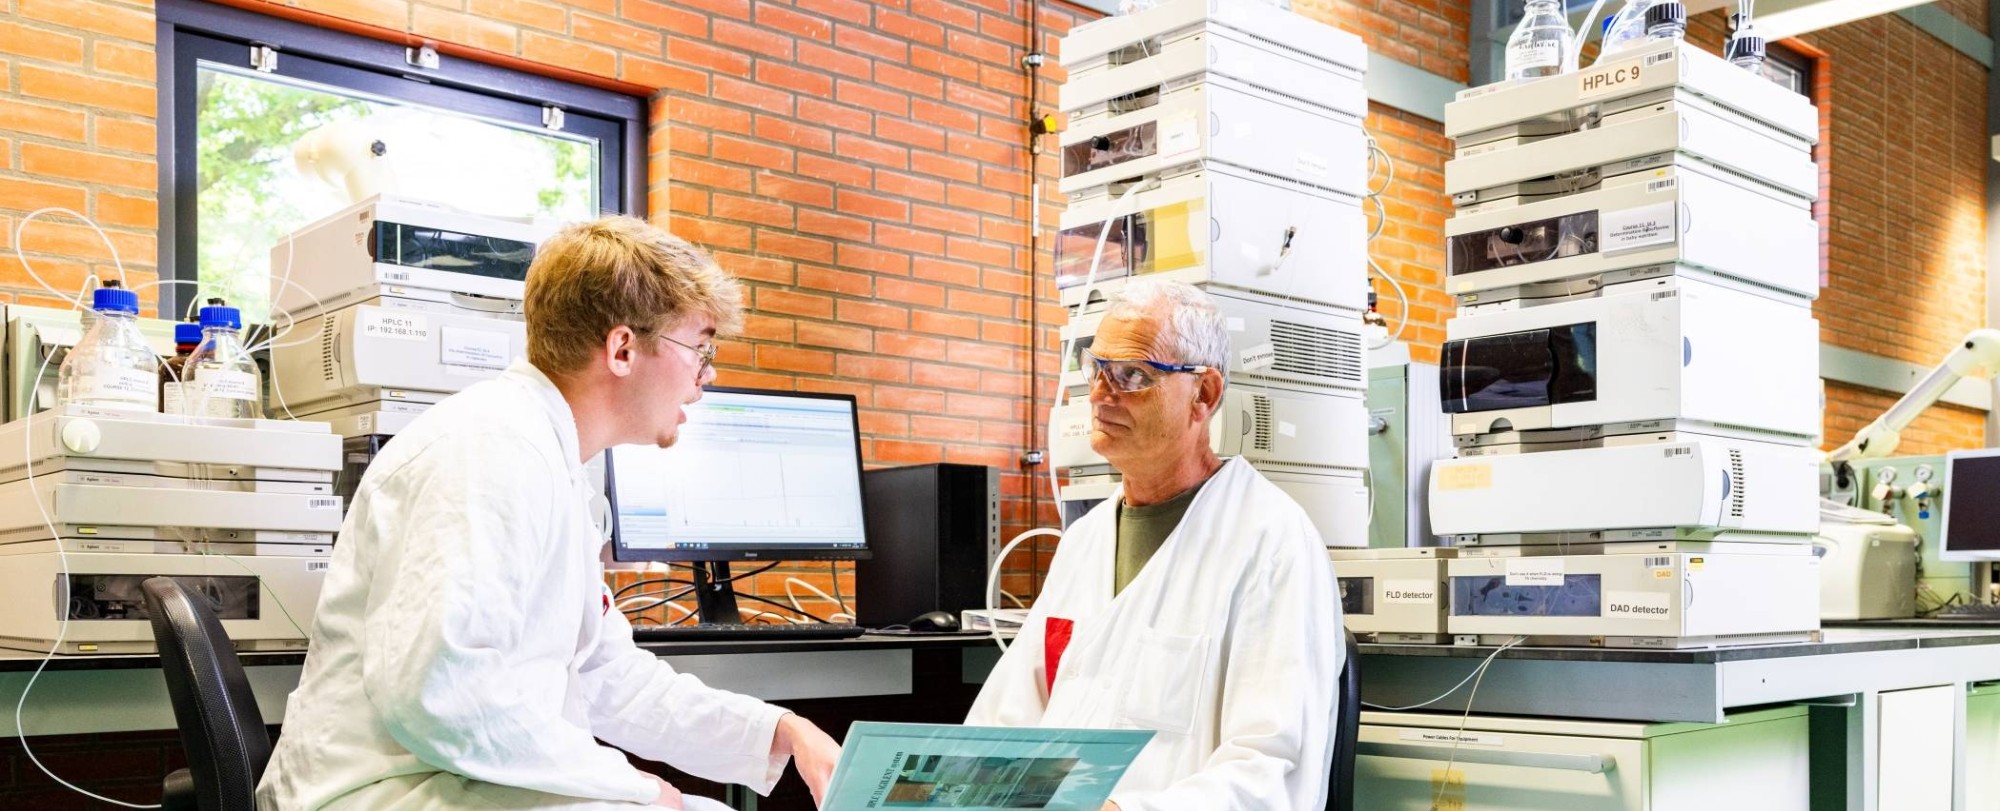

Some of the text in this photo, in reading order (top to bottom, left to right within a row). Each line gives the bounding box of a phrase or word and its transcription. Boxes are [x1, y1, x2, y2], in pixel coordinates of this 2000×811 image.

[1583, 65, 1640, 91] HPLC 9
[382, 318, 402, 326] HPLC
[1385, 590, 1433, 599] FLD detector
[1610, 603, 1668, 615] DAD detector
